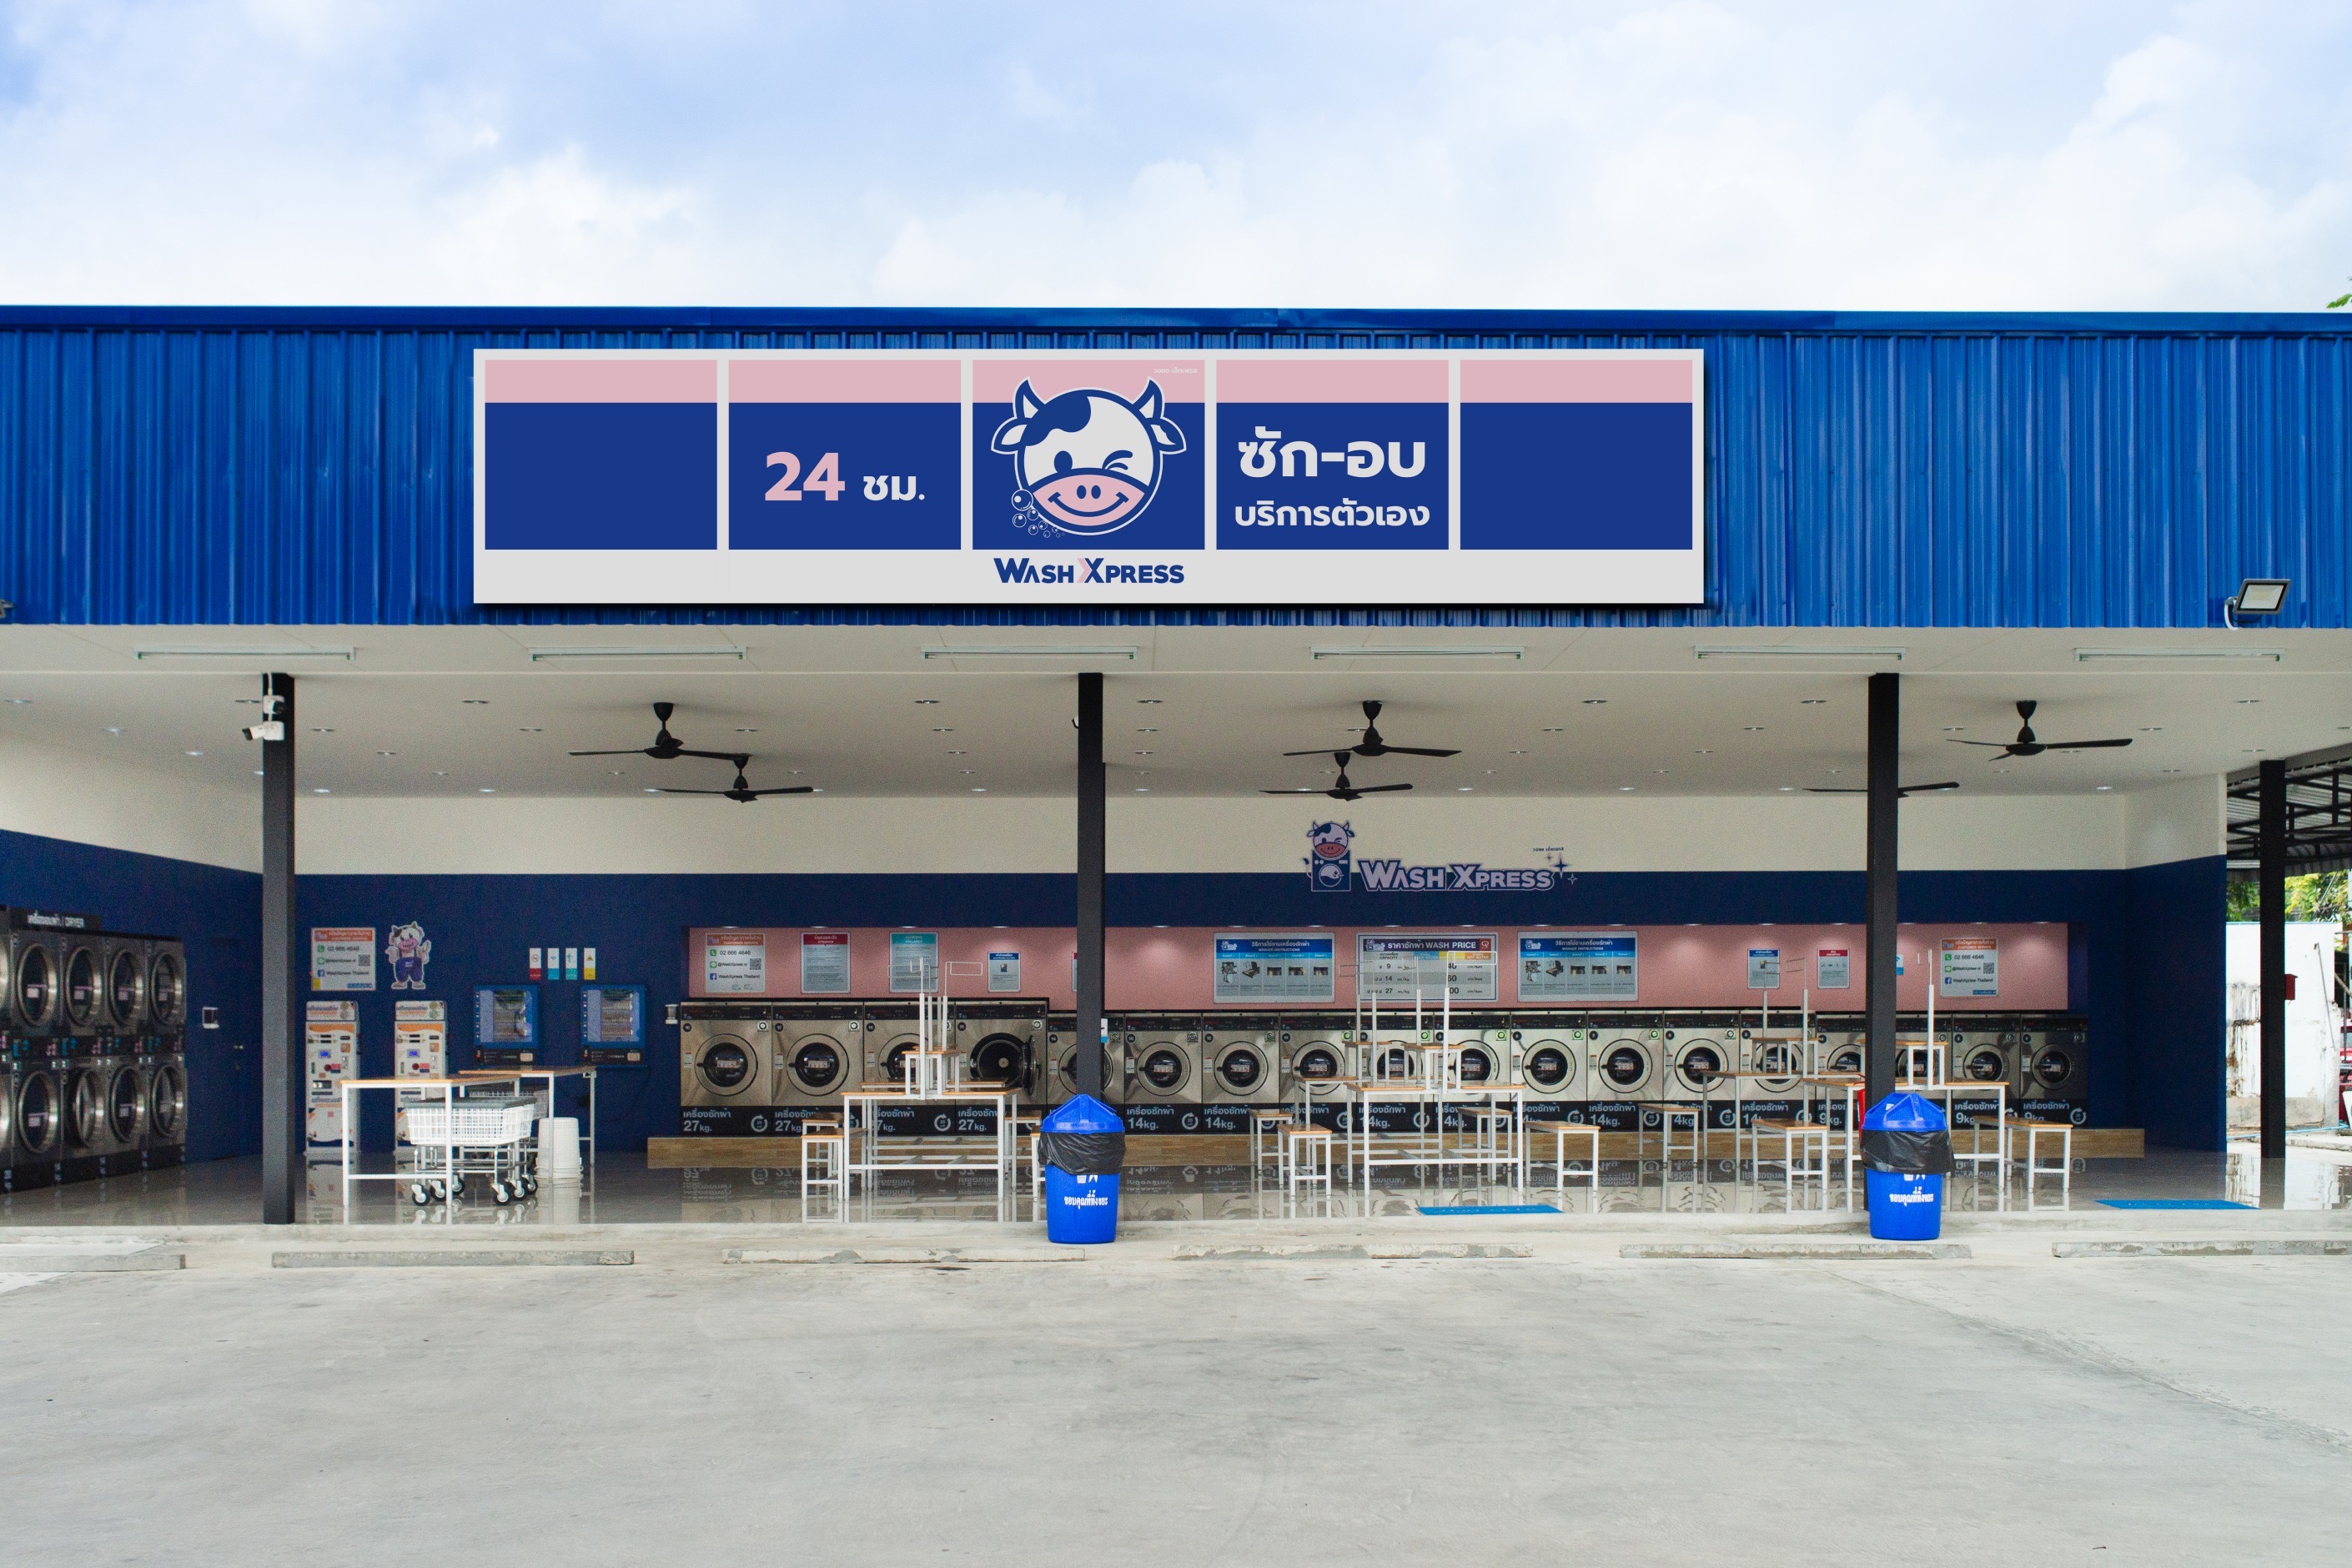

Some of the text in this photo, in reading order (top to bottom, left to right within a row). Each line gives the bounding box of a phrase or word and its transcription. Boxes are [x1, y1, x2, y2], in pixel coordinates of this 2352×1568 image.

[1239, 426, 1426, 478] ซัก-อบ
[764, 451, 925, 501] 24 ชม.
[1234, 497, 1430, 527] บริการตัวเอง
[993, 557, 1185, 584] WASH XPRESS
[1359, 859, 1555, 890] WASH XPRESS
[1388, 940, 1425, 949] ราคาซักผ้า
[1127, 1104, 1174, 1116] เครื่องซักผ้า
[1590, 1102, 1636, 1113] เครื่องซักผ้า
[1741, 1101, 1788, 1111] เครื่องซักผ้า
[2023, 1100, 2069, 1110] เครื่องซักผ้า
[683, 1108, 731, 1118] เครื่องซักผ้า
[683, 1120, 712, 1133] 27kg.
[959, 1119, 987, 1132] 27kg.
[1128, 1118, 1159, 1131] 14kg.
[1206, 1118, 1236, 1130] 14kg.
[1591, 1114, 1620, 1127] 14kg.
[1064, 1189, 1108, 1209] ขอบคุณที่ทิ้งขยะ
[1889, 1186, 1934, 1206] ขอบคุณที่ทิ้งขยะ
